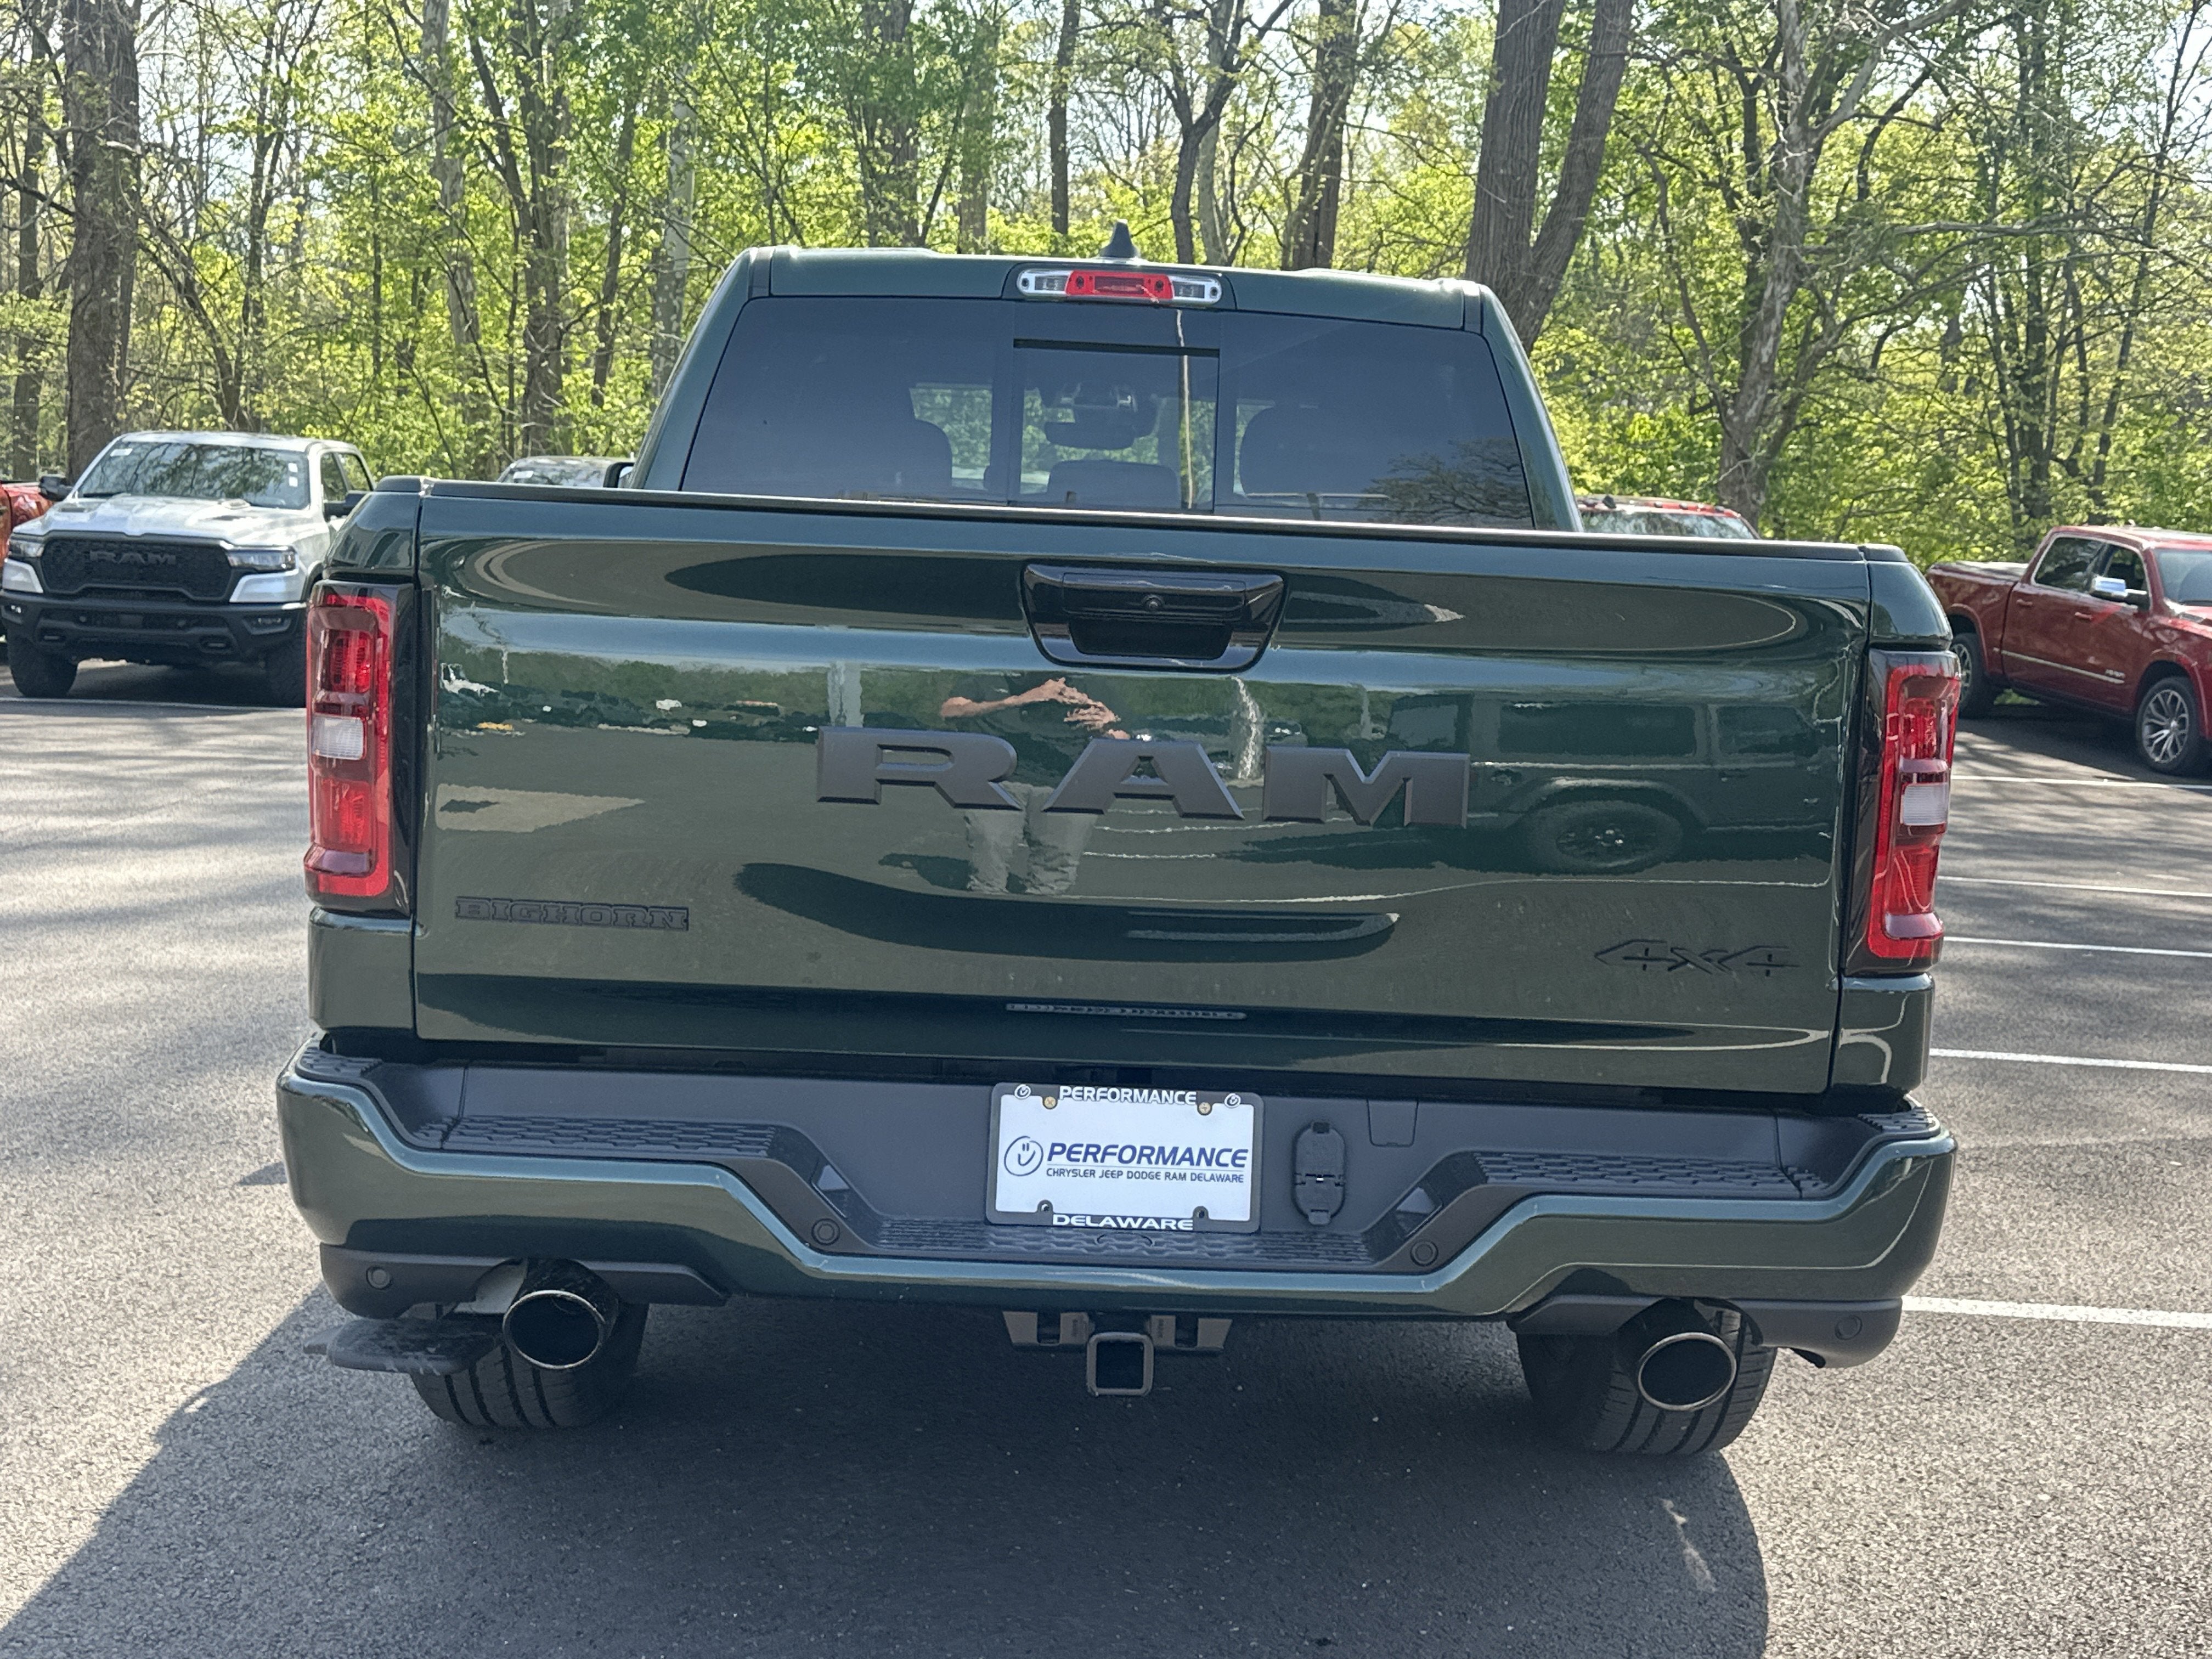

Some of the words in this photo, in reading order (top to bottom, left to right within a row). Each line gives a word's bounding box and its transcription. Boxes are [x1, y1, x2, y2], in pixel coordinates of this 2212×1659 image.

[89, 550, 176, 565] RAM
[817, 726, 1471, 829] RAM
[455, 896, 689, 931] BIGHORN
[1059, 1085, 1197, 1105] PERFORMANCE
[1047, 1142, 1249, 1168] PERFORMANCE
[1046, 1168, 1096, 1178] CHRYSLER
[1099, 1170, 1124, 1180] JEEP
[1127, 1171, 1161, 1181] DODGE
[1164, 1172, 1187, 1181] RAM
[1190, 1173, 1244, 1183] DELAWARE
[1052, 1214, 1194, 1231] DELAWARE
